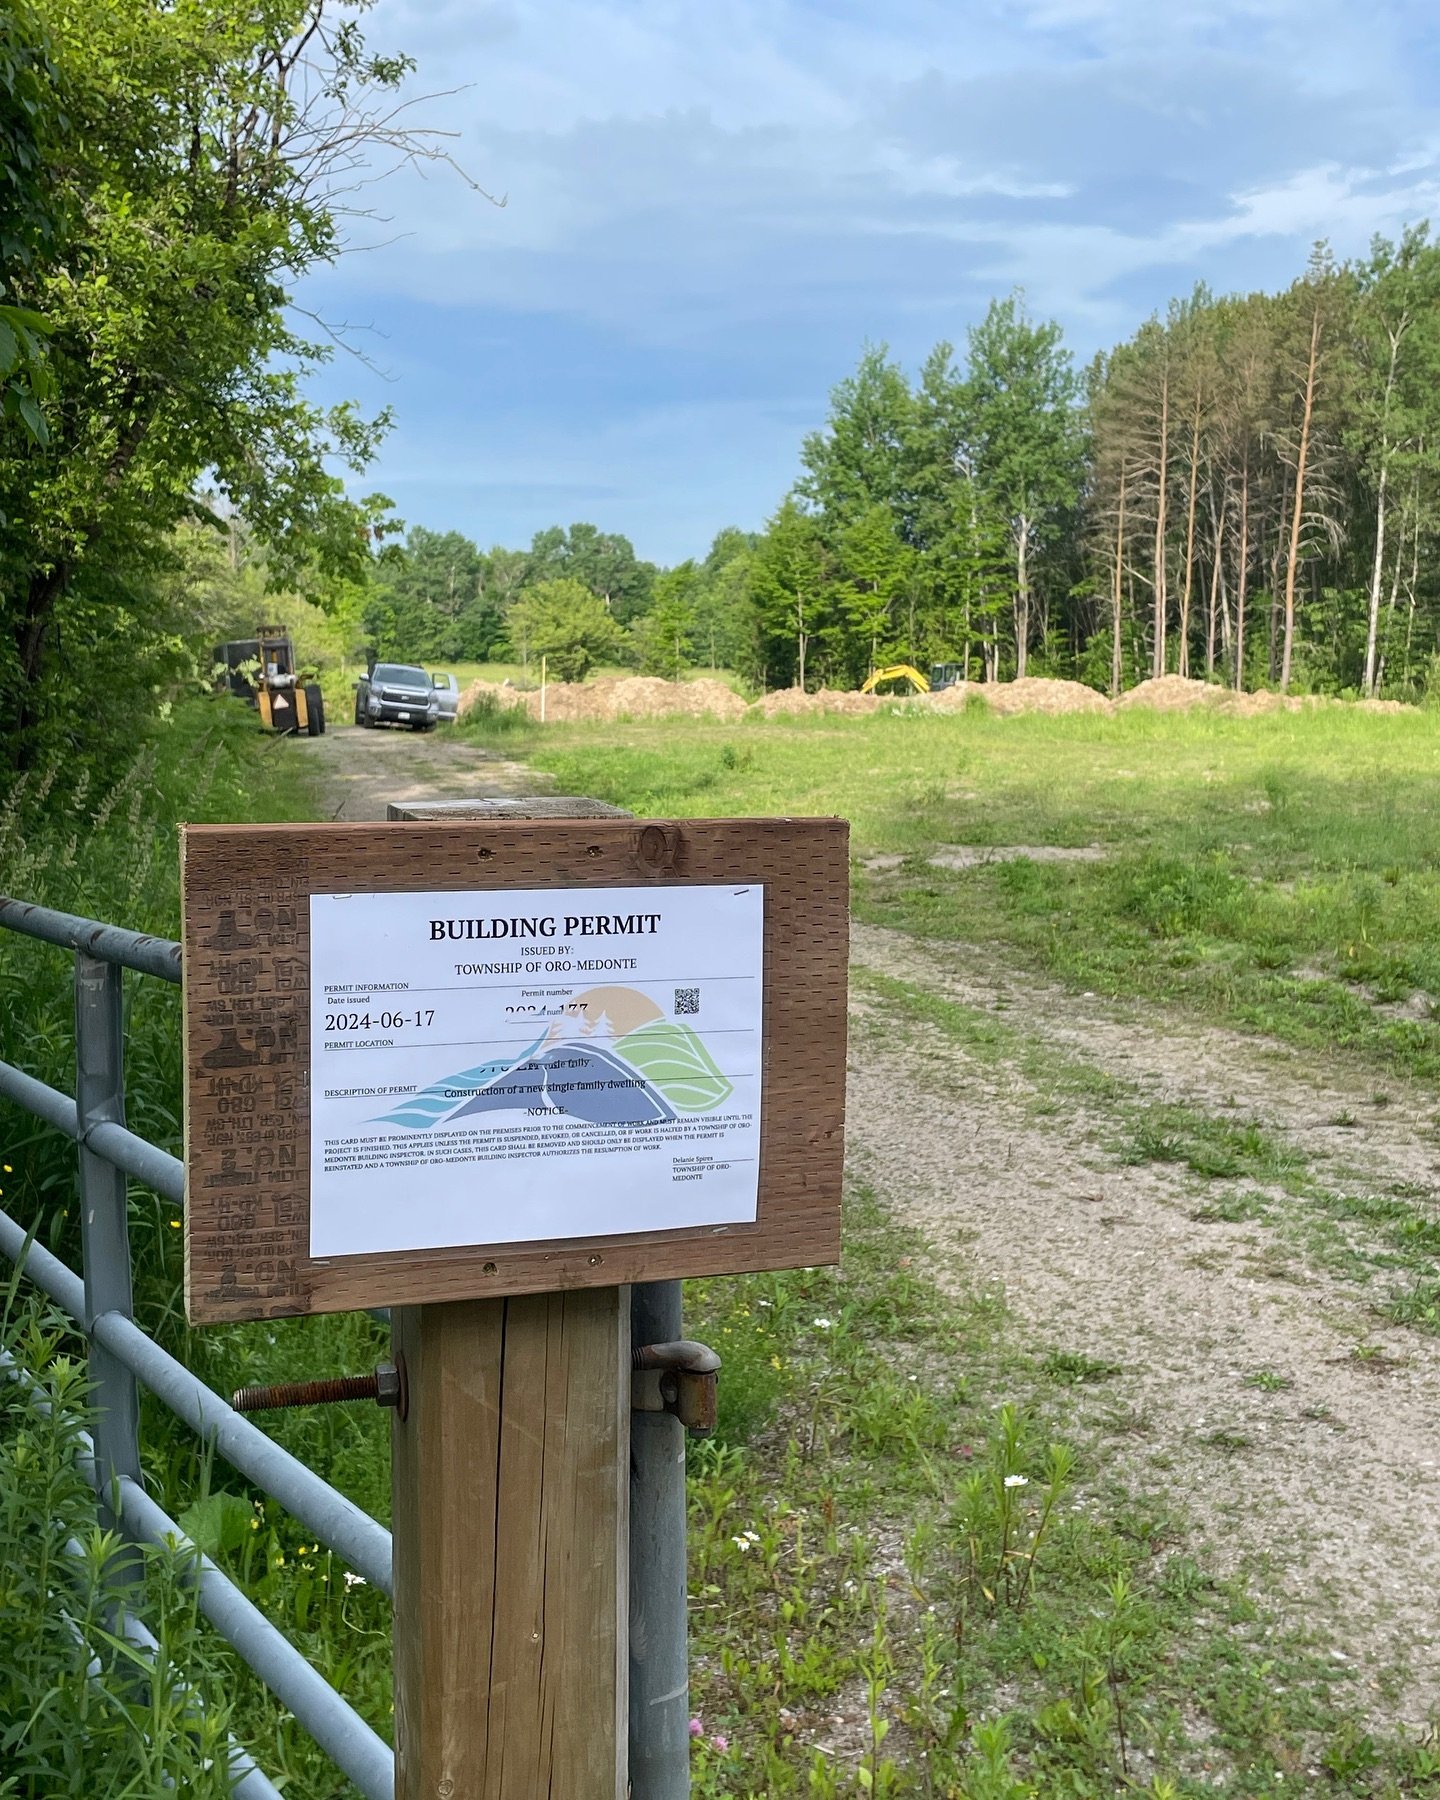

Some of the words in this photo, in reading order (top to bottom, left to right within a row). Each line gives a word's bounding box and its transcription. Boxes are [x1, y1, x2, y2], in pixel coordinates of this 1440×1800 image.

[428, 917, 556, 940] BUILDING
[563, 914, 661, 936] PERMIT
[520, 946, 555, 955] ISSUED
[557, 945, 574, 954] BY:
[454, 962, 522, 974] TOWNSHIP
[524, 961, 542, 972] OF
[544, 958, 636, 971] ORO-MEDONTE
[324, 1010, 435, 1030] 2024-06-17
[324, 1087, 376, 1096] DESCRIPTION
[444, 1086, 504, 1097] Construction
[506, 1085, 518, 1094] of
[546, 1082, 575, 1094] single
[576, 1081, 606, 1092] family
[606, 1079, 646, 1090] dwelling
[522, 1106, 568, 1116] -NOTICE-
